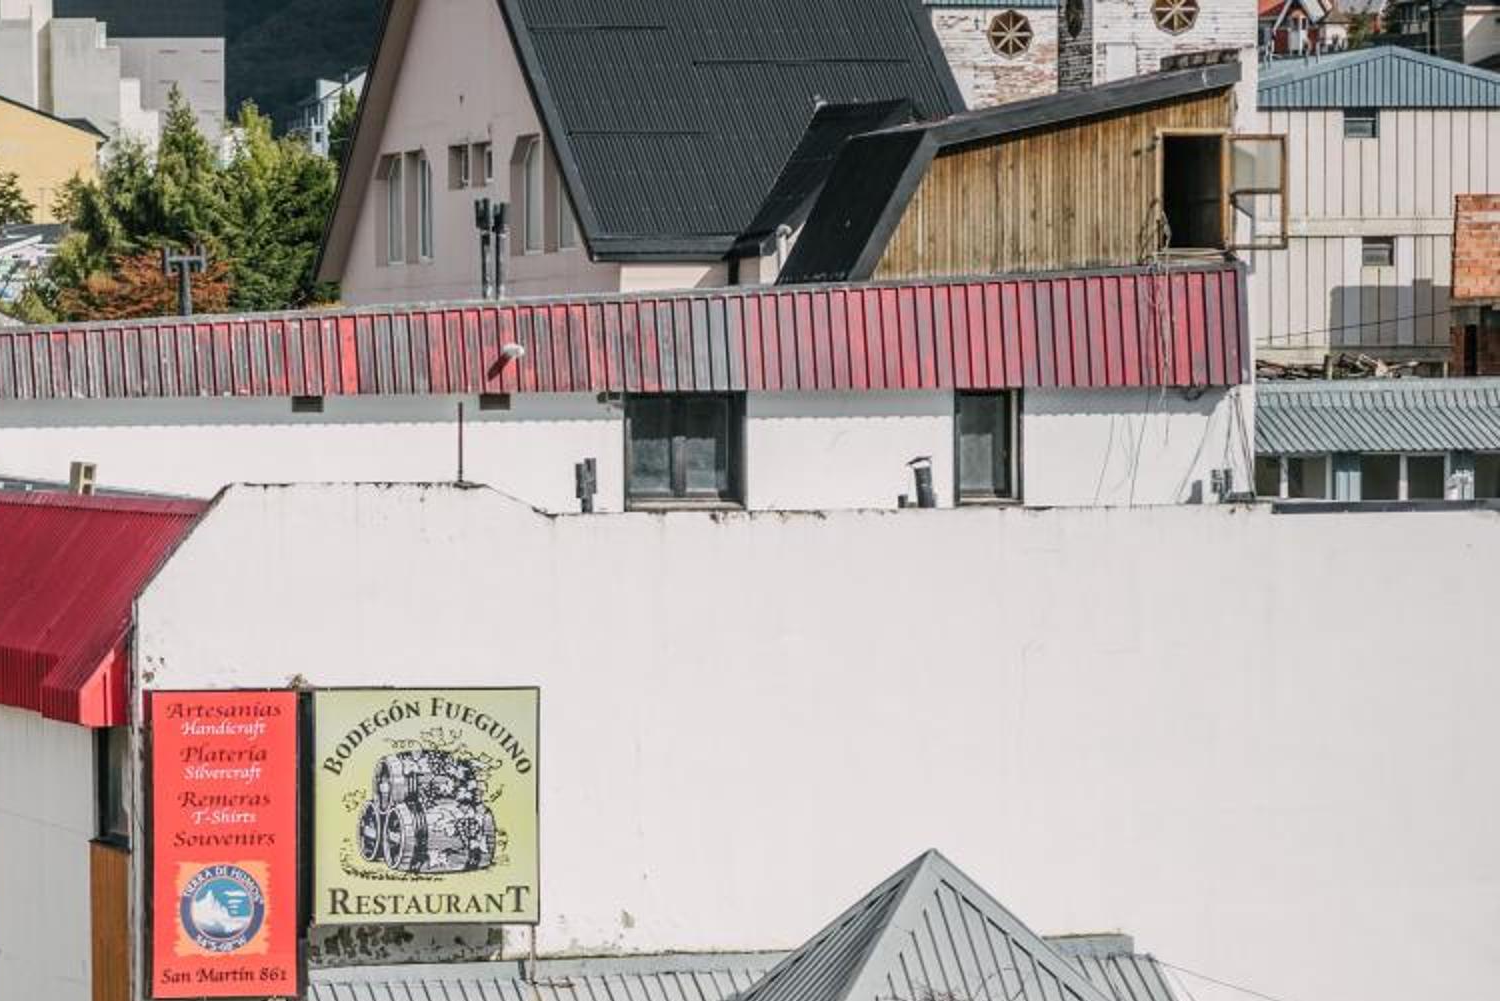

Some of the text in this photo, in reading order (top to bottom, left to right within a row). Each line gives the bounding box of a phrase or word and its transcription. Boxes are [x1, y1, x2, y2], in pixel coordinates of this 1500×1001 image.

[181, 718, 266, 740] Handicraft
[323, 697, 532, 776] BODEGÓN FUEGUINO
[184, 763, 262, 784] Silvercraft
[177, 791, 272, 808] Remeras
[192, 808, 257, 825] T-Shirts
[173, 830, 276, 848] Souvenirs
[328, 885, 531, 915] RESTAURANT
[162, 968, 191, 984] San
[259, 966, 287, 981] 861
